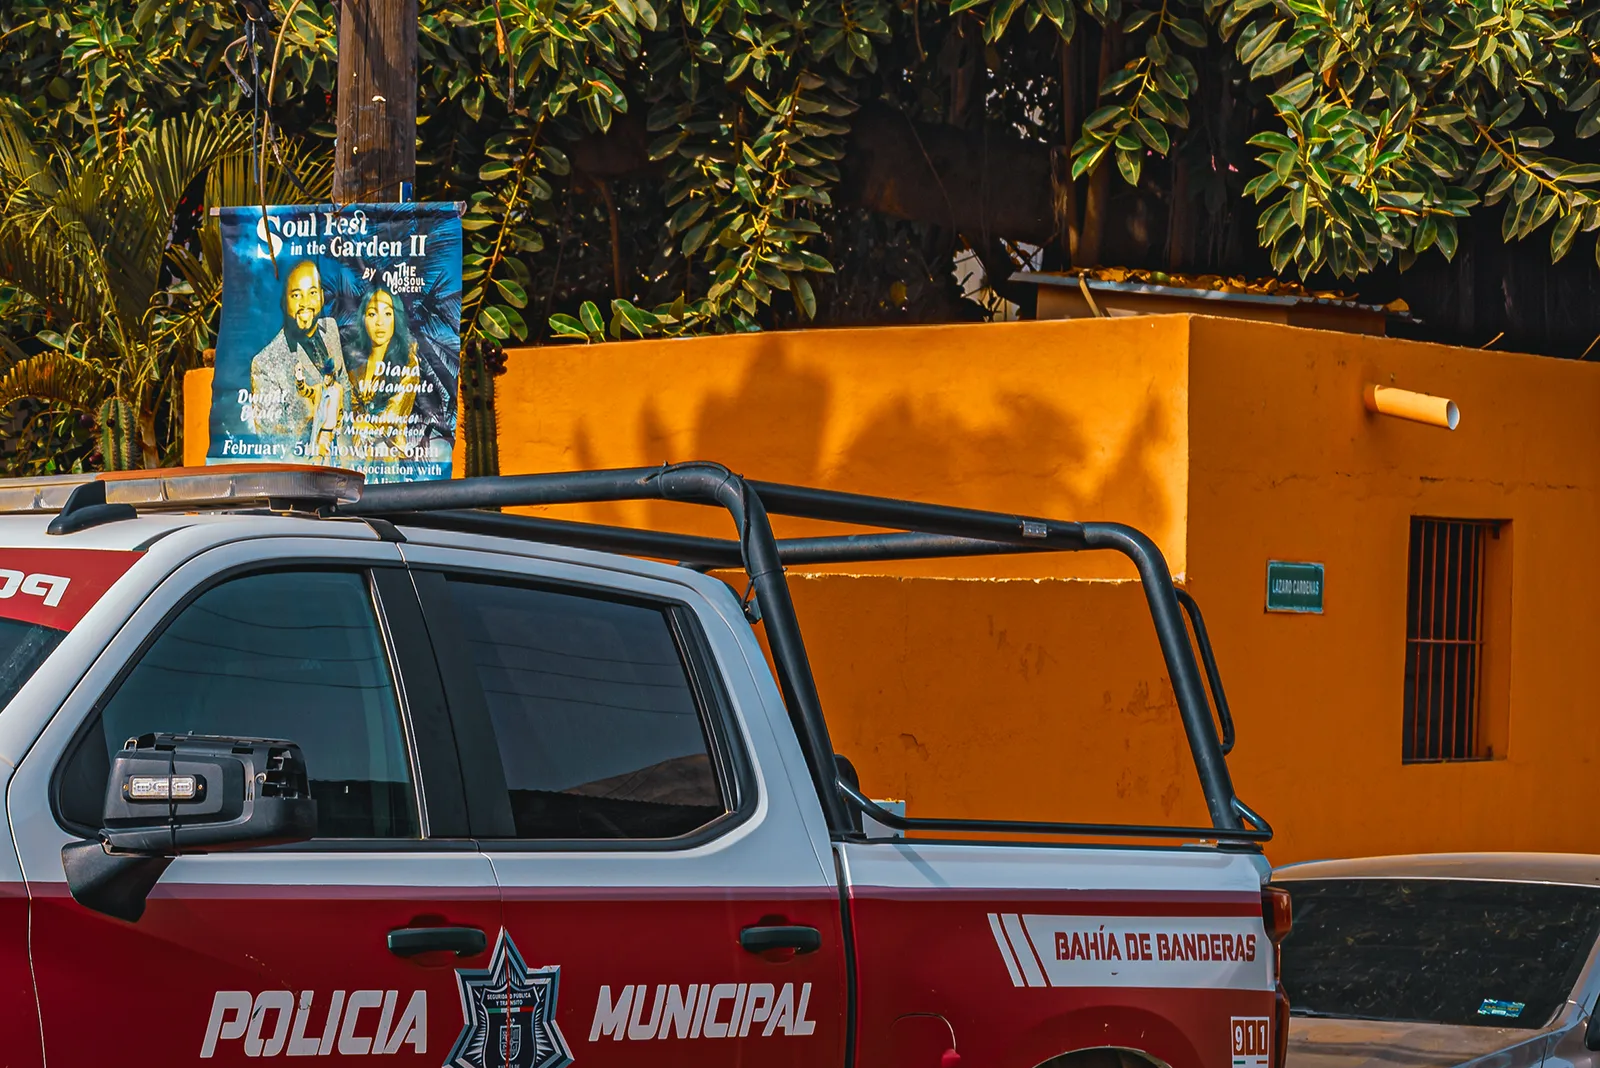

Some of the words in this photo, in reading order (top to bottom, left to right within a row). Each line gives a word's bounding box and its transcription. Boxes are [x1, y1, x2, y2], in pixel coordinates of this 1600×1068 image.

[256, 212, 317, 260] Soul
[323, 210, 370, 235] Fest
[290, 241, 301, 256] in
[306, 241, 327, 256] the
[330, 235, 402, 258] Garden
[362, 267, 377, 282] BY
[393, 261, 417, 278] THE
[374, 361, 421, 377] Diana
[221, 439, 288, 459] February
[293, 440, 319, 456] 5th
[404, 442, 440, 462] 6pm
[417, 463, 443, 477] with
[1054, 925, 1122, 961] BAHÍA
[1124, 932, 1154, 962] DE
[1157, 932, 1257, 963] BANDERAS
[199, 989, 429, 1059] POLICIA
[587, 982, 817, 1043] MUNICIPAL
[1235, 1025, 1266, 1052] 911
